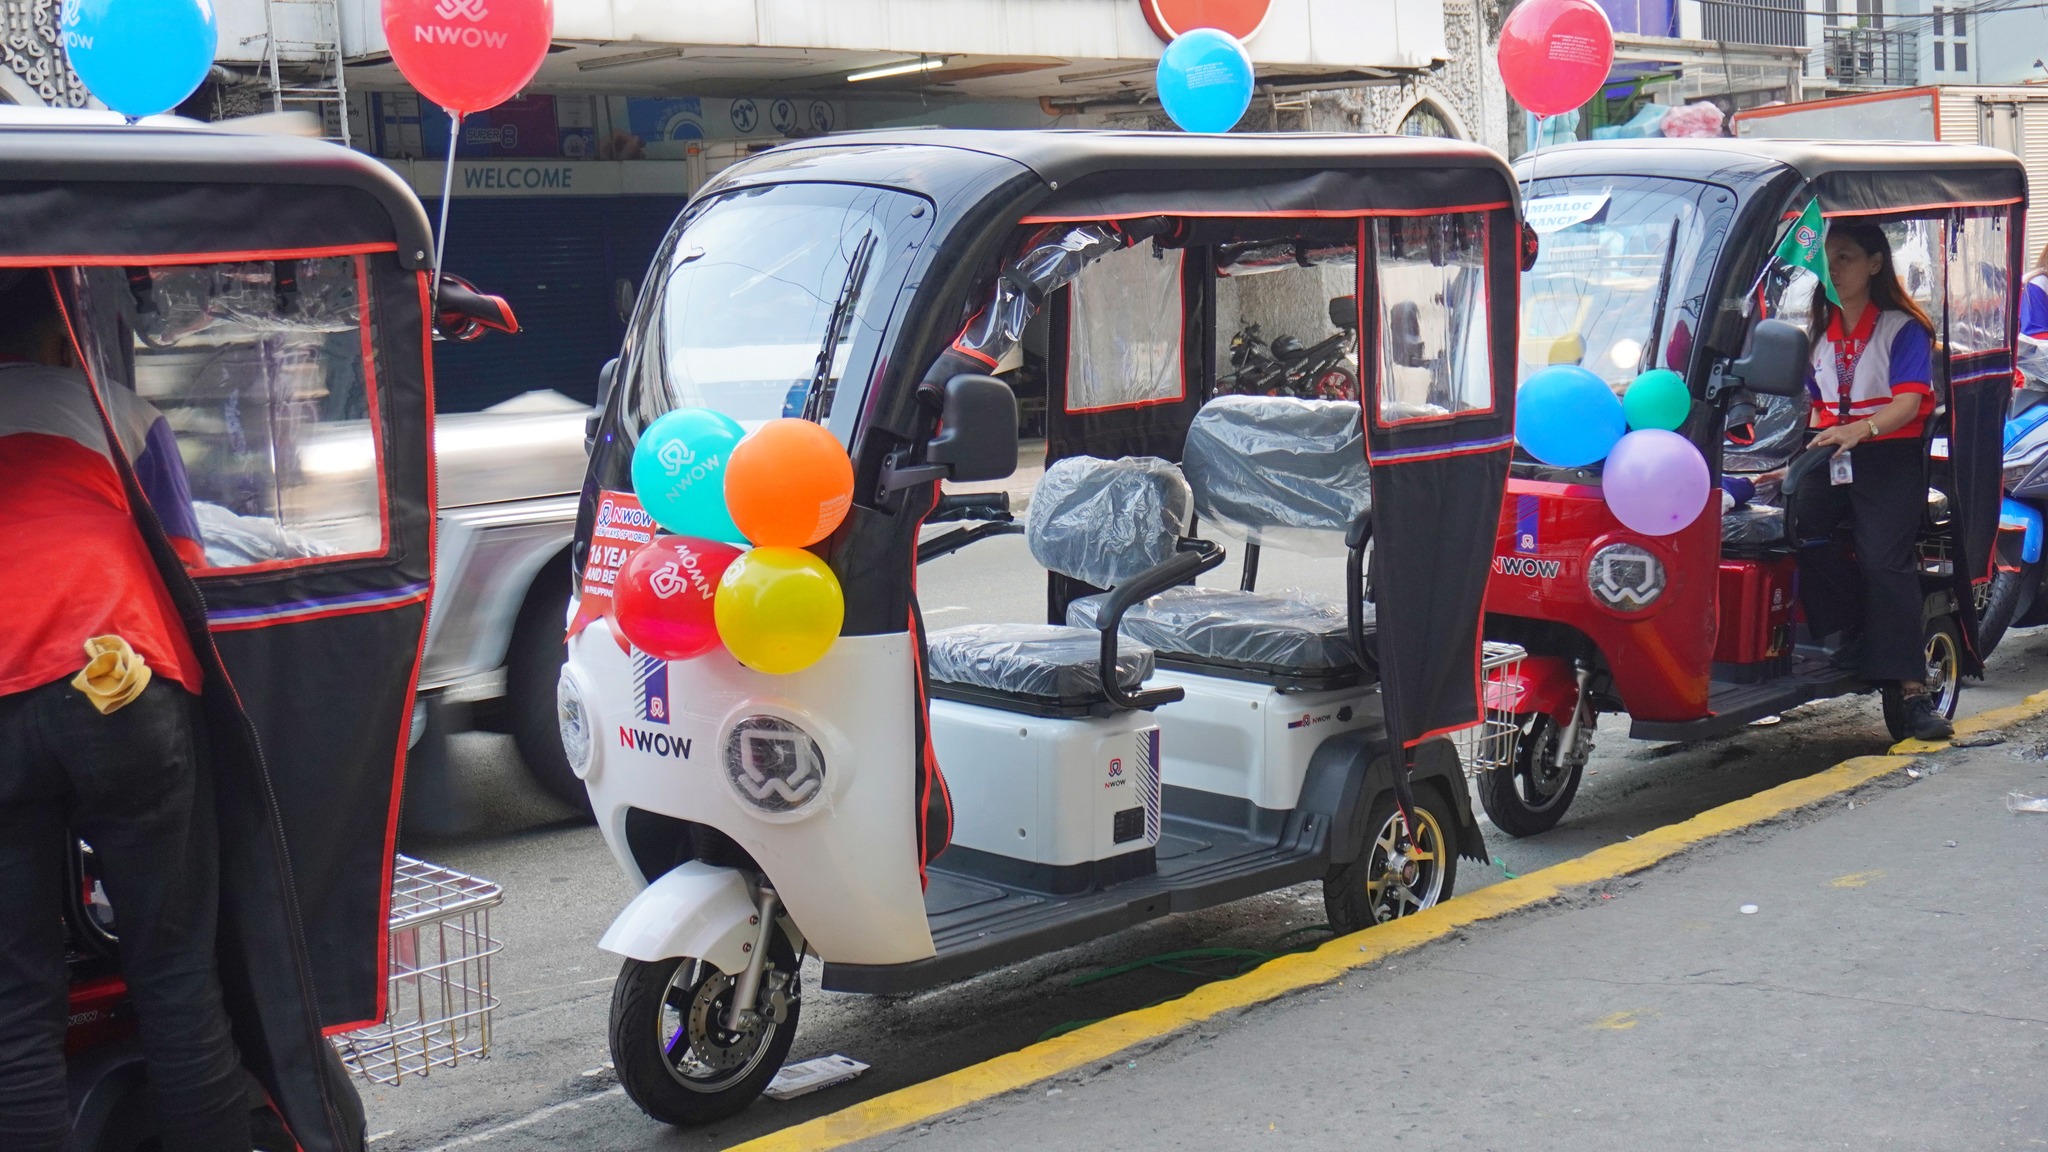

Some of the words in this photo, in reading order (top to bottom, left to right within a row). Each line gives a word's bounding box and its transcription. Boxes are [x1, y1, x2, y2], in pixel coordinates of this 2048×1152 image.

[415, 25, 508, 49] NWOW
[466, 127, 501, 143] SUPER
[464, 167, 573, 189] WELCOME
[1529, 202, 1593, 214] MPALOC
[665, 454, 720, 504] NWOW
[612, 506, 653, 528] NWOW
[620, 529, 629, 540] OF
[628, 531, 650, 543] WORLD
[590, 544, 602, 565] 16
[585, 567, 602, 582] AND
[674, 544, 714, 600] NWOW
[1492, 556, 1560, 578] NWOW
[620, 726, 692, 759] NWOW
[1104, 779, 1126, 789] NWOW
